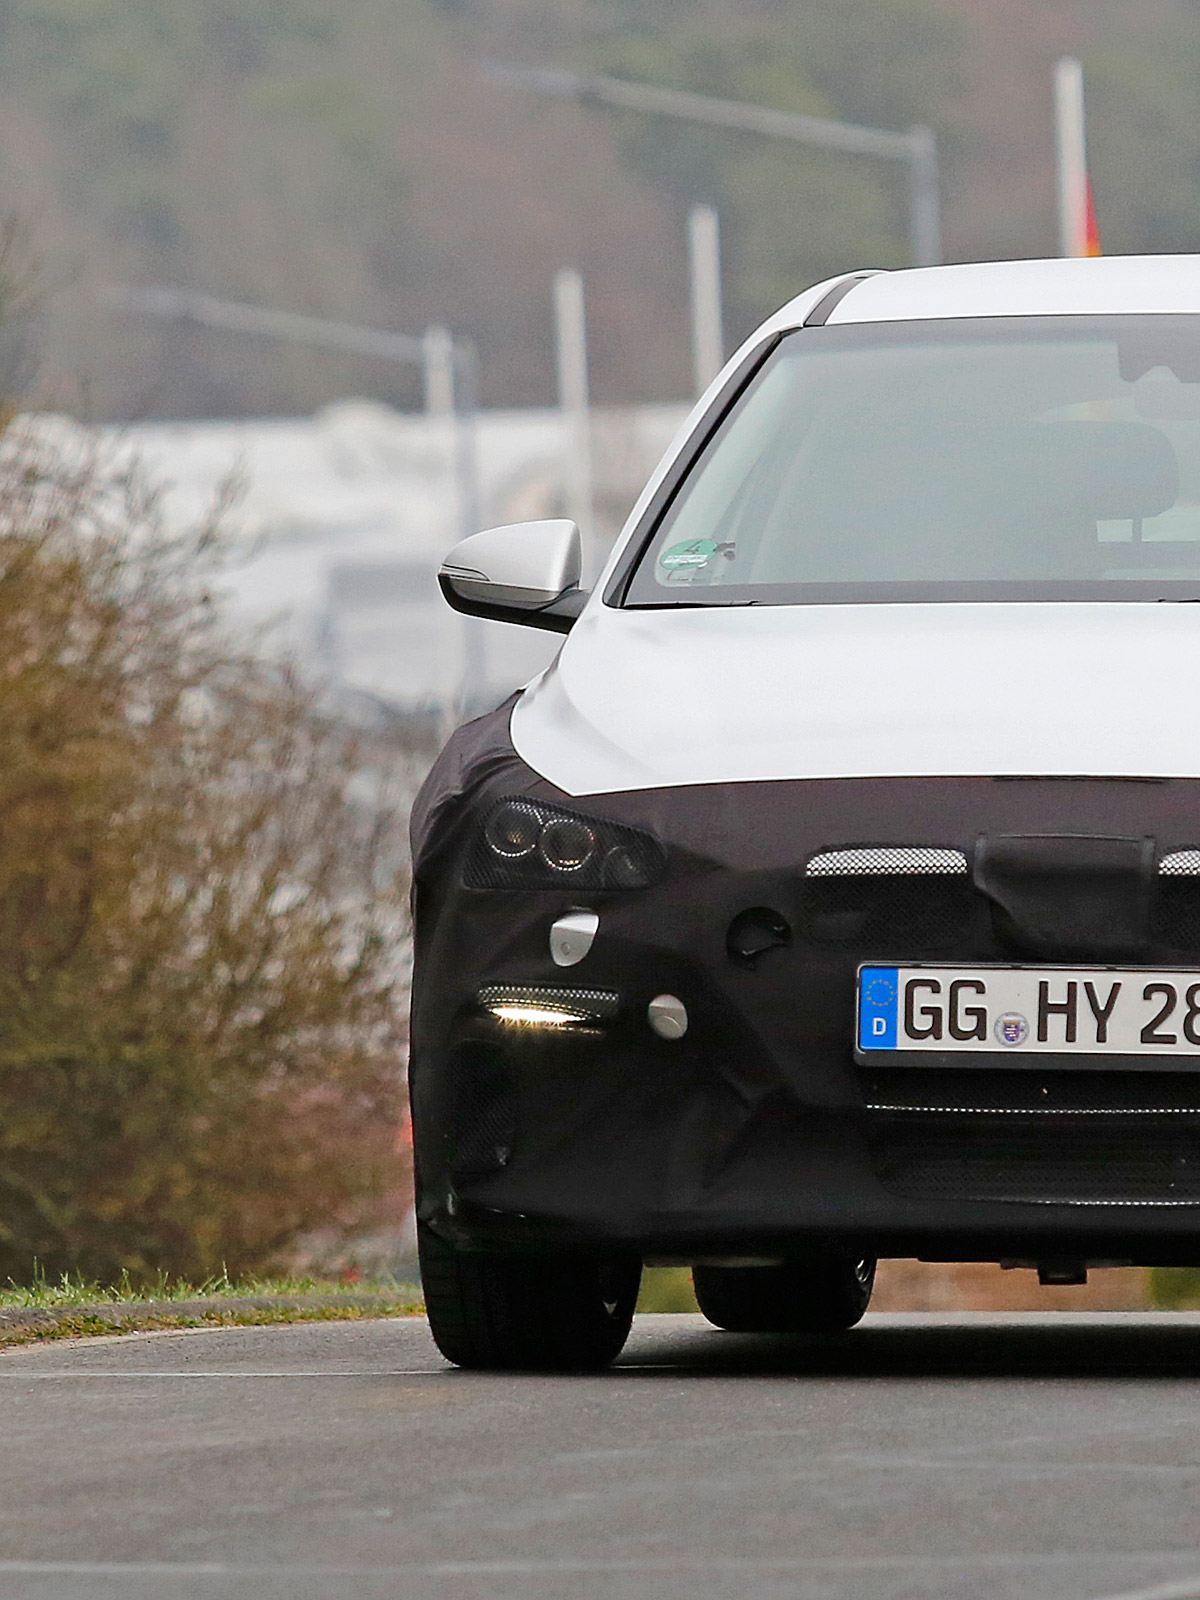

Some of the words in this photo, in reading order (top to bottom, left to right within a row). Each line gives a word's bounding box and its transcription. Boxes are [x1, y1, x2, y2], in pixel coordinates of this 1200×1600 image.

[872, 1017, 887, 1036] D
[904, 978, 987, 1041] GG
[1037, 981, 1122, 1043] HY
